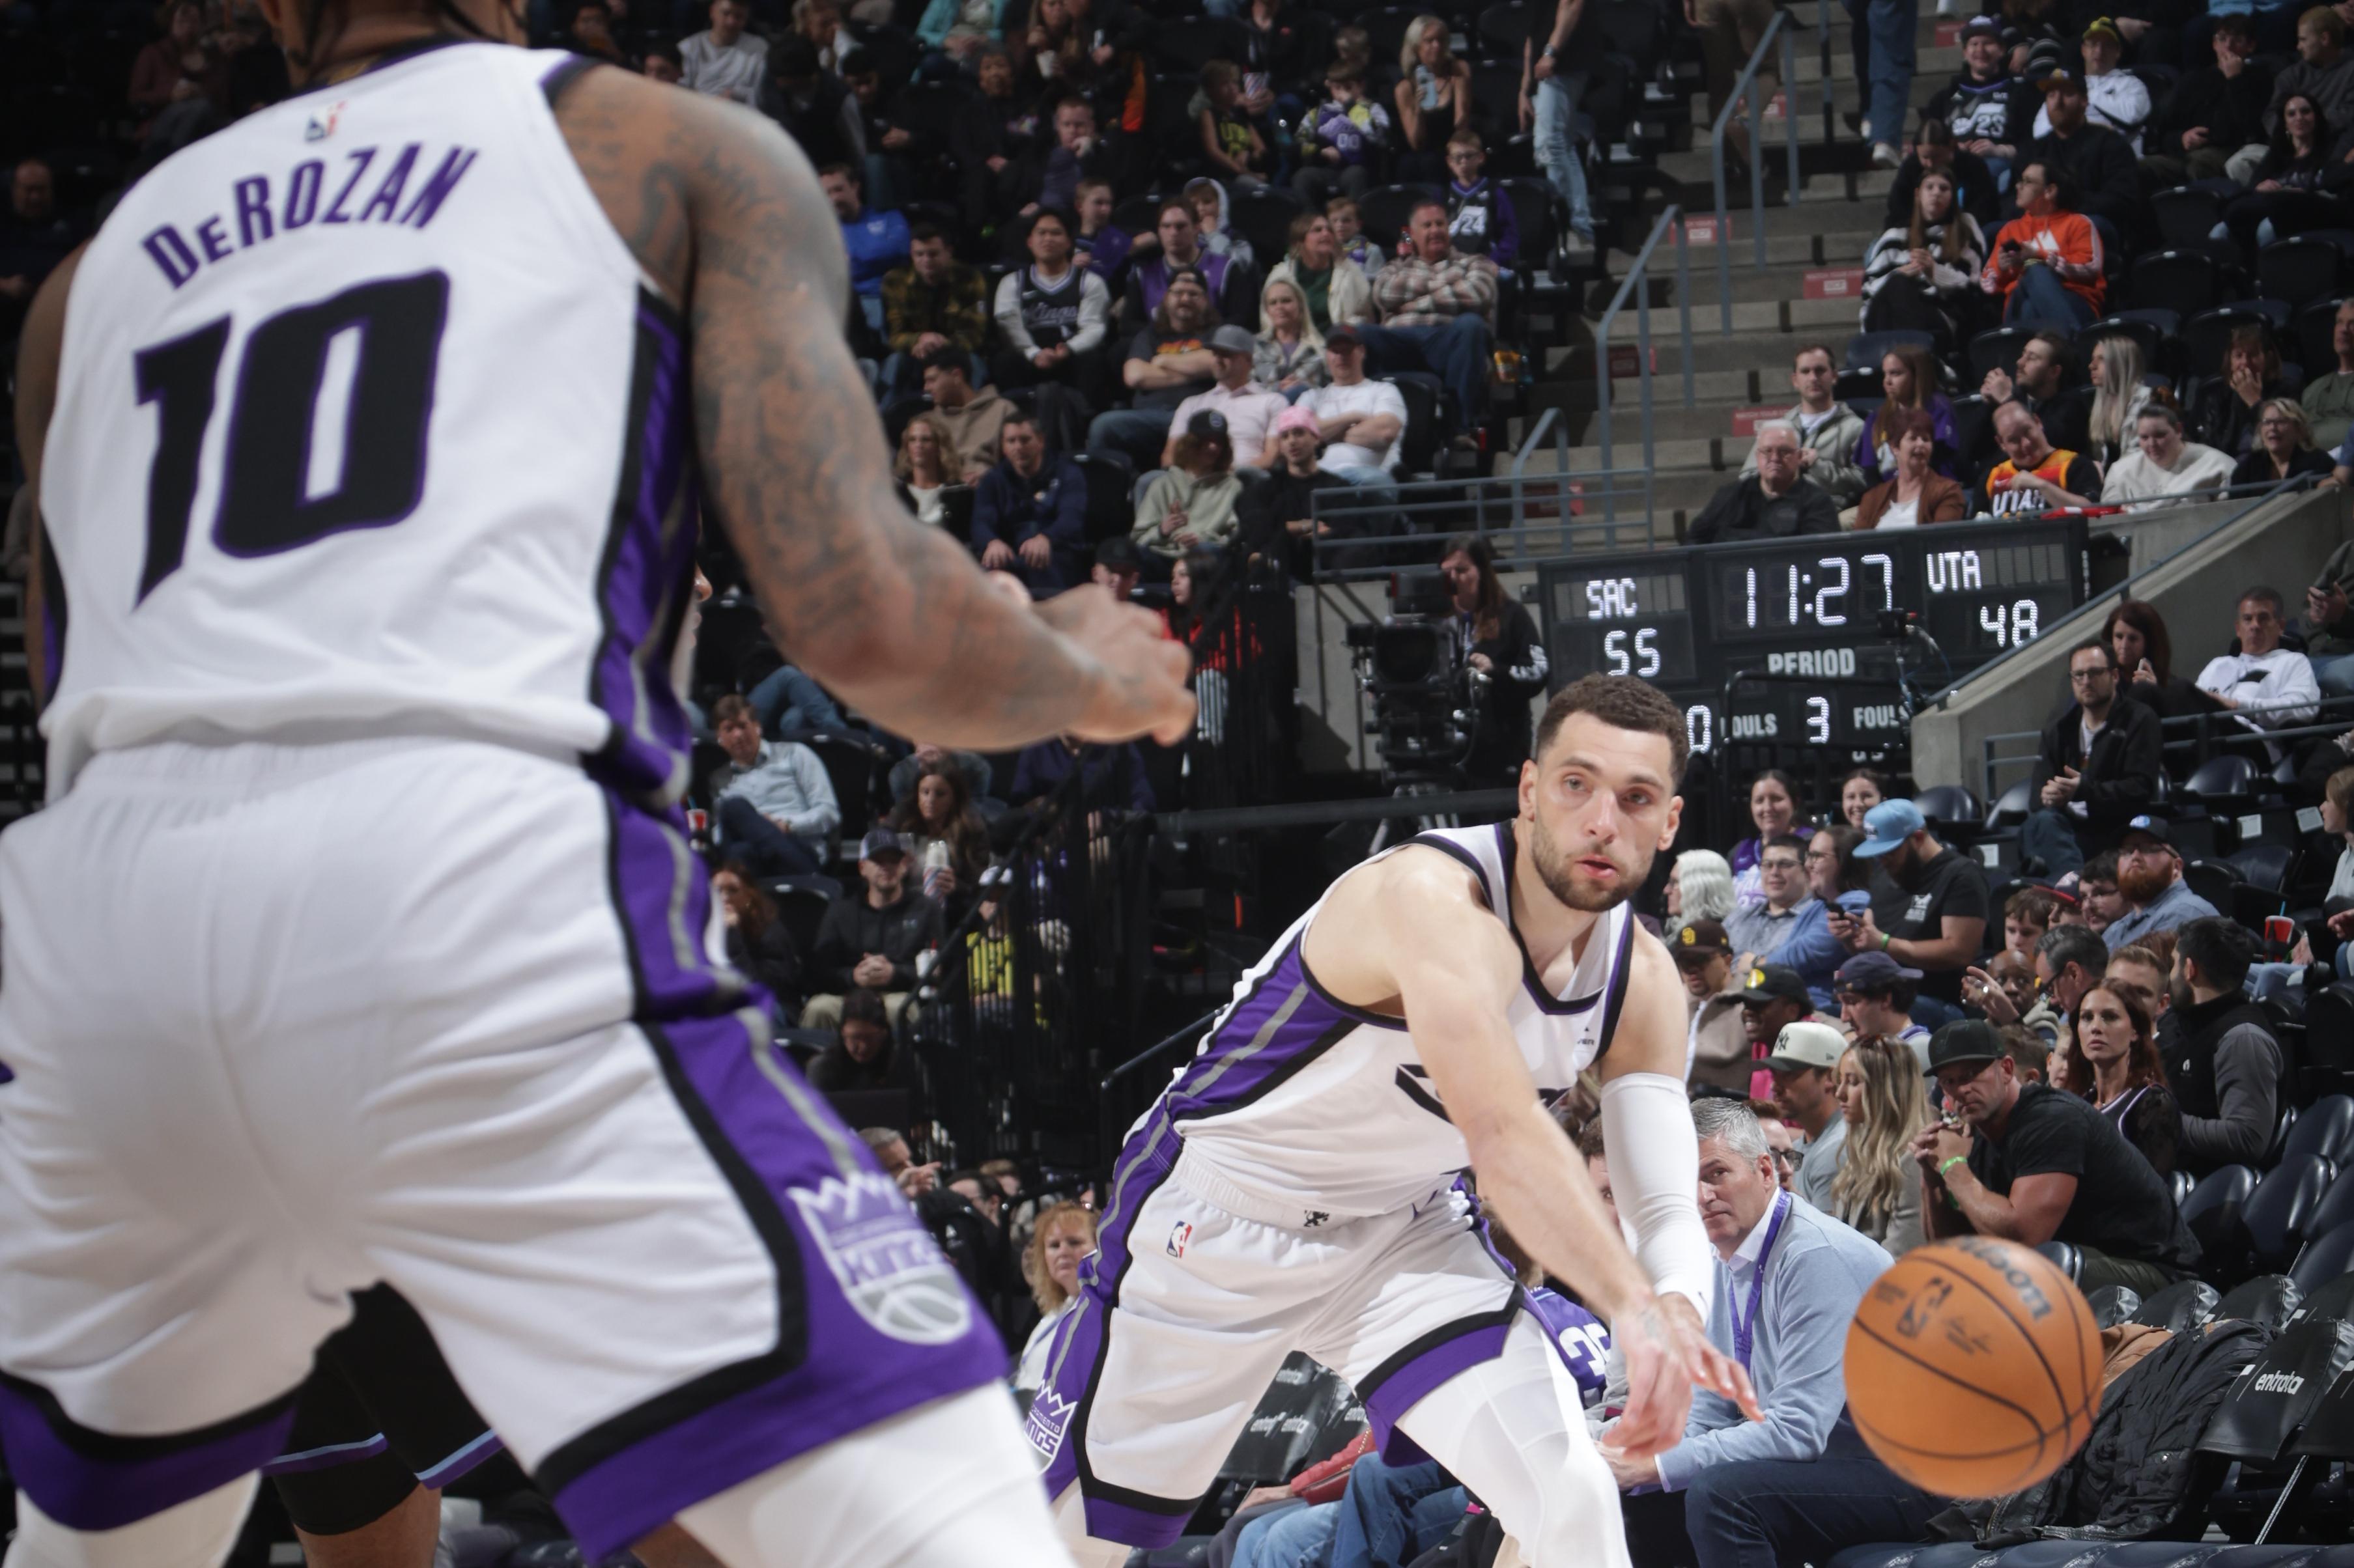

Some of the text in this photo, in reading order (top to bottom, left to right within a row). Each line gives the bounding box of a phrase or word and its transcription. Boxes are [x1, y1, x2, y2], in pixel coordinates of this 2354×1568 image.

[140, 143, 479, 290] DeROZAN
[133, 266, 451, 611] 10
[1747, 553, 1892, 628] 11:27
[1926, 551, 1982, 593] UTA
[1586, 578, 1638, 619] SAC
[1980, 600, 2037, 647] 48
[1604, 628, 1660, 677] 55
[1767, 648, 1855, 677] PERIOD
[1720, 713, 1778, 739] OULS
[1806, 697, 1829, 744] 3
[2255, 1369, 2305, 1395] entrata
